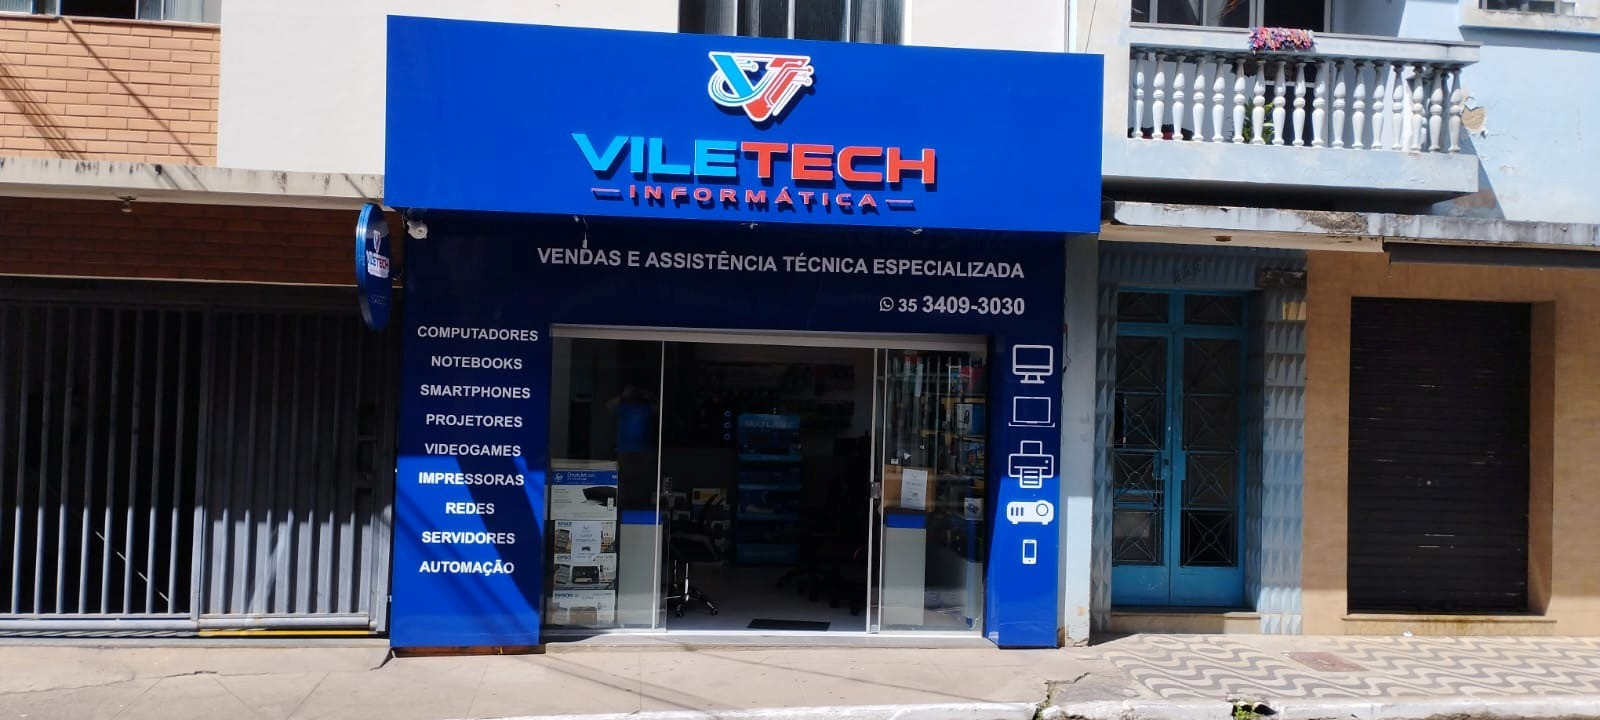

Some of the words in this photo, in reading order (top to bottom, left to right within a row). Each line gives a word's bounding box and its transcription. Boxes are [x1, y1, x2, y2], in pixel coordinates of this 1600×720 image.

[571, 133, 936, 185] VILETECH
[629, 185, 878, 208] INFORMÁTICA
[537, 247, 621, 266] VENDAS
[628, 250, 640, 267] E
[645, 250, 777, 272] ASSISTÊNCIA
[783, 253, 868, 274] TÉCNICA
[873, 258, 1025, 278] ESPECIALIZADA
[898, 298, 918, 312] 35
[922, 295, 1025, 315] 3409-3030
[417, 326, 539, 341] COMPUTADORES
[431, 355, 522, 369] NOTEBOOKS
[420, 384, 531, 399] SMARTPHONES
[426, 413, 523, 428] PROJETORES
[425, 443, 521, 457] VIDEOGAMES
[418, 472, 525, 486] IMPRESSORAS
[445, 502, 495, 515] REDES
[421, 531, 516, 545] SERVIDORES
[419, 560, 515, 576] AUTOMAÇÃO
